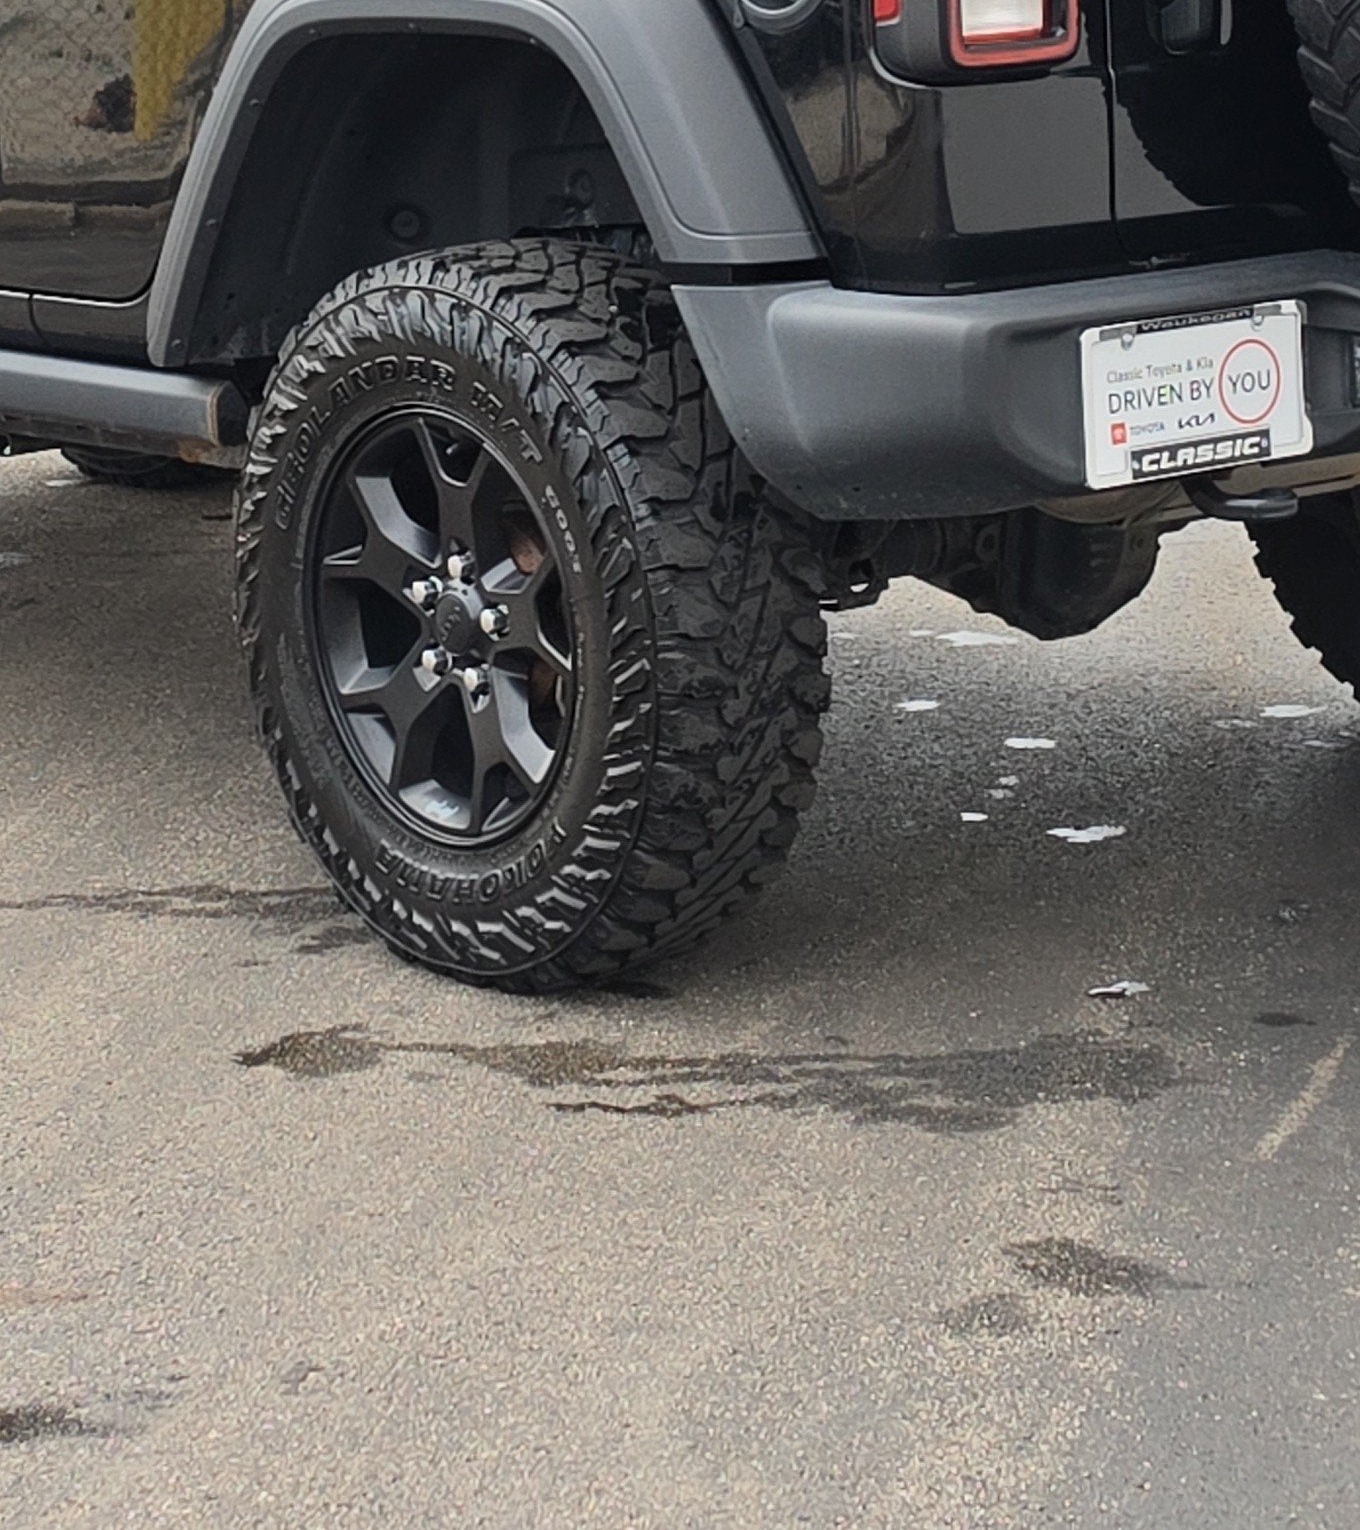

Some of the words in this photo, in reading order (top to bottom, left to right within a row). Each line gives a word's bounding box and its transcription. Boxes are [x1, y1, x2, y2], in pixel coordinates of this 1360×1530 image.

[1140, 308, 1252, 331] Waukegan
[1105, 367, 1143, 384] Classic
[1145, 363, 1183, 379] Toyota
[1196, 356, 1214, 370] Kia
[1108, 381, 1184, 415] DRIVEN
[1189, 377, 1215, 402] BY
[1226, 368, 1272, 395] YOU
[274, 354, 456, 531] GEOLANDAR
[1131, 420, 1166, 436] TOYOTA
[1141, 435, 1262, 472] CLASSIC
[375, 815, 567, 905] YOKOHAMA
